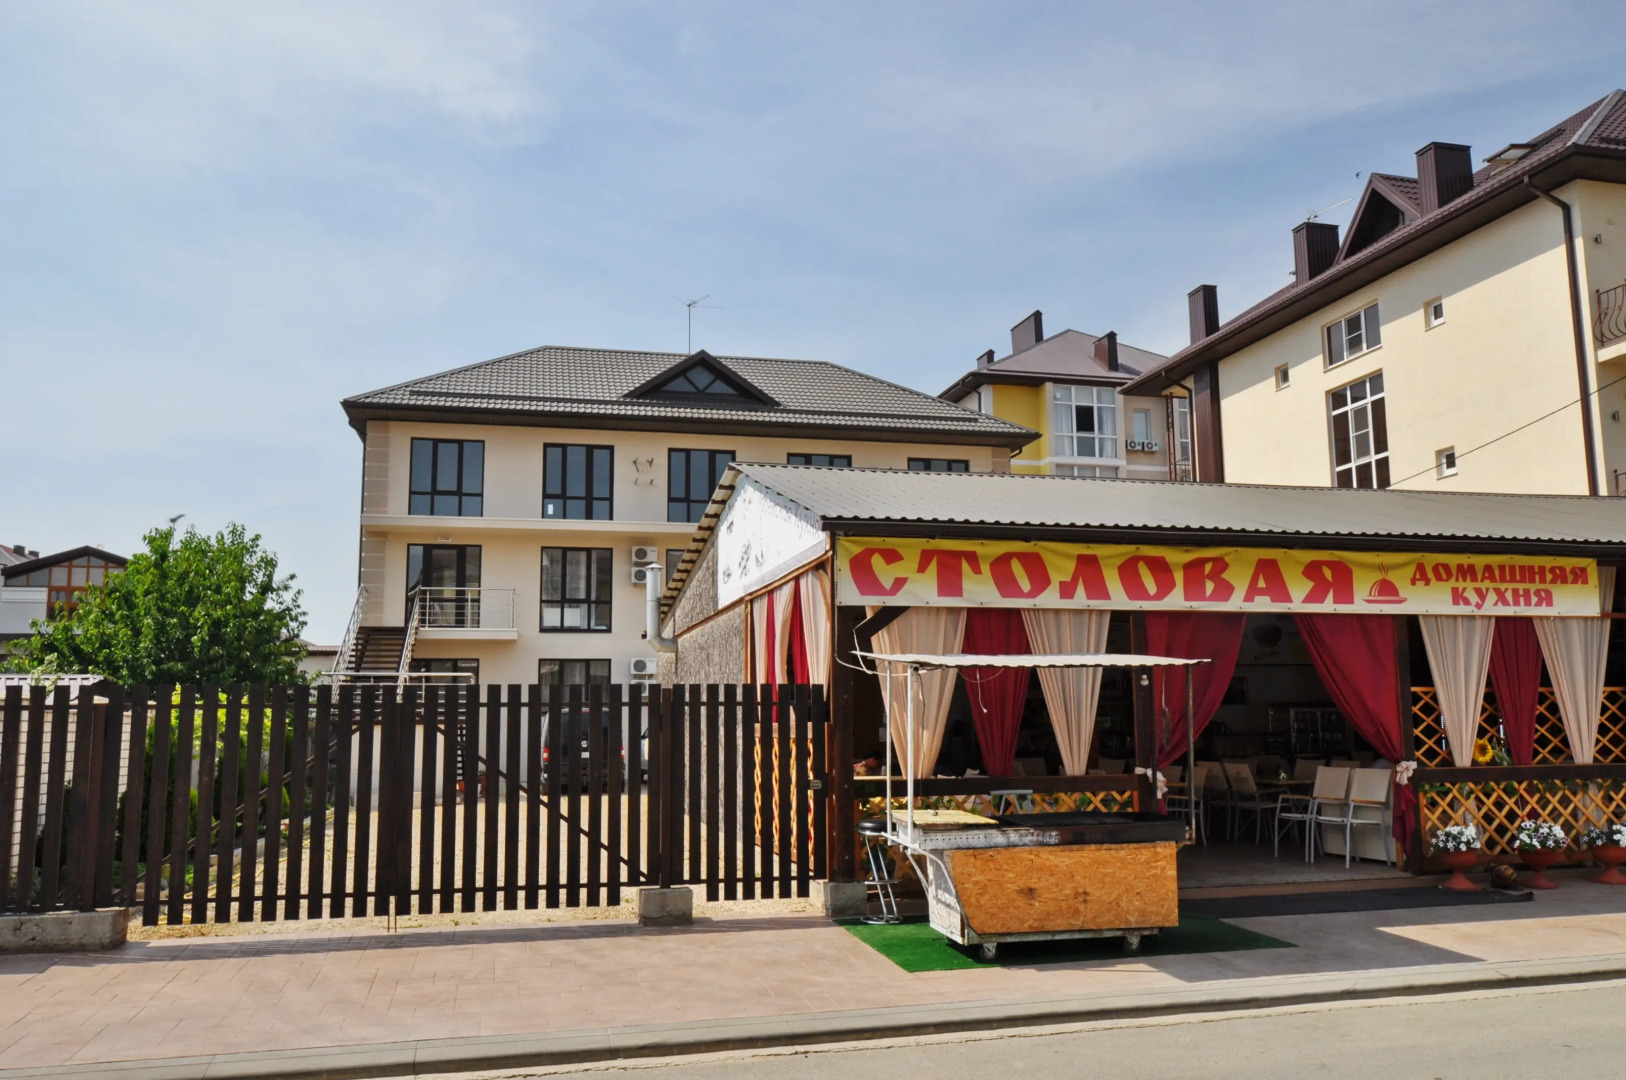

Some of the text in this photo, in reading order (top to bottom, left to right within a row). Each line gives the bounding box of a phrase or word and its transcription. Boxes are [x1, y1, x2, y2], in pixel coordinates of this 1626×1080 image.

[849, 547, 1355, 605] СТОЛОВАЯ
[1410, 562, 1589, 586] ДОМАШНЯЯ
[1451, 586, 1554, 611] КУХНЯ
